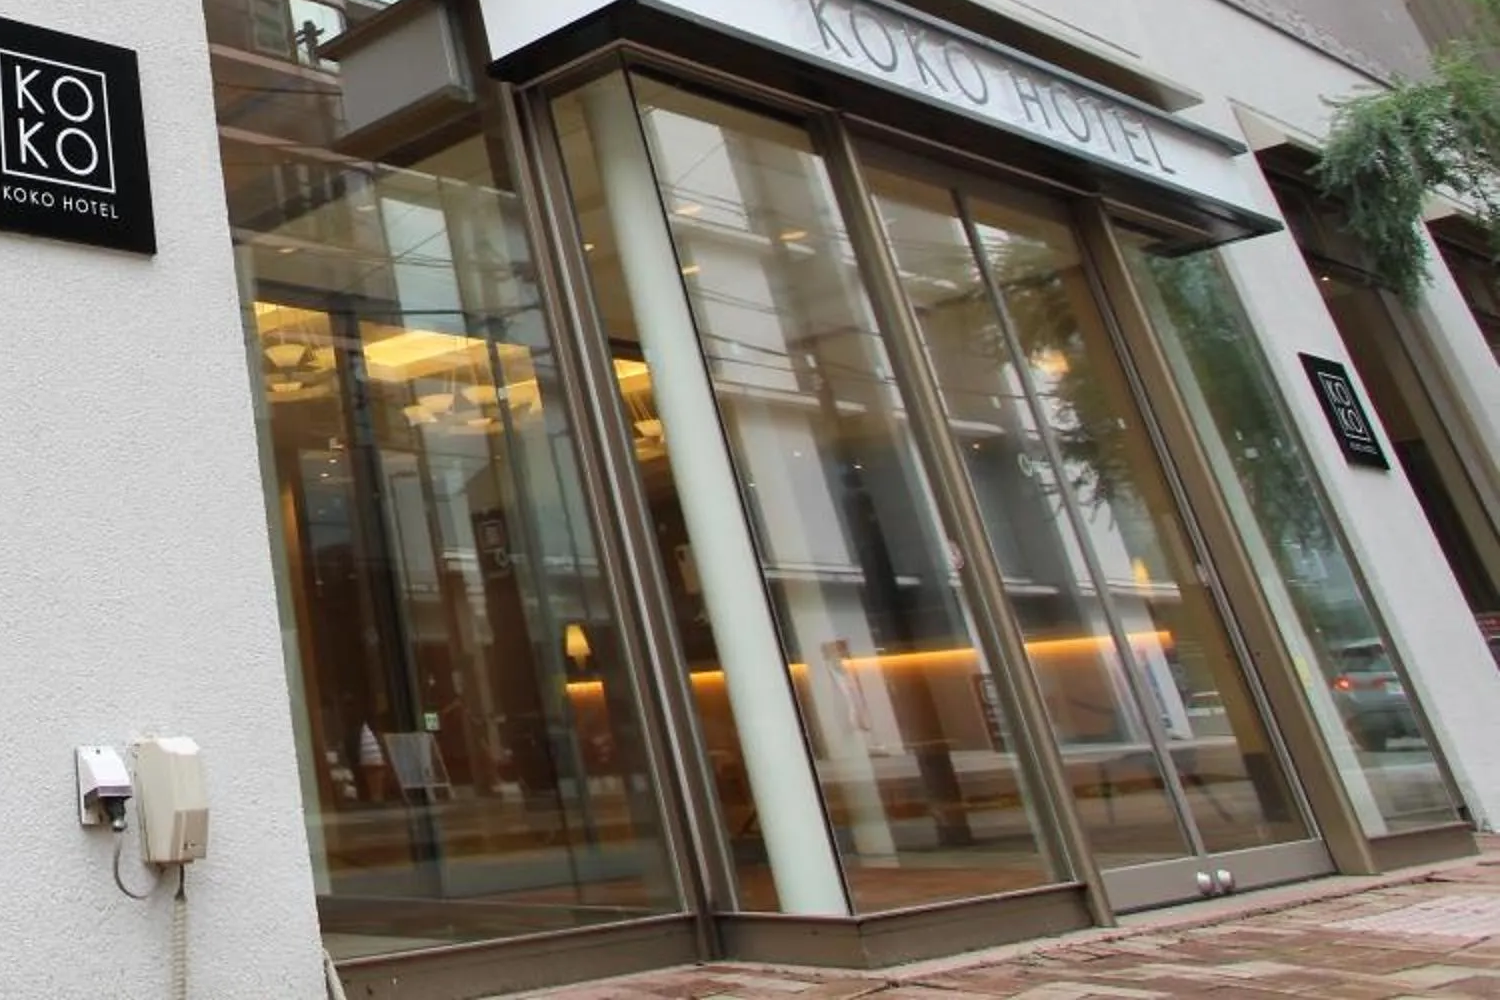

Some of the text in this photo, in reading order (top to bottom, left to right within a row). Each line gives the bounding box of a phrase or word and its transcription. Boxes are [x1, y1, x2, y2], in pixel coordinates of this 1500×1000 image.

[15, 64, 94, 122] KO
[1008, 66, 1176, 175] HOTEL
[17, 117, 98, 176] KO
[3, 185, 119, 219] KOKO HOTEL
